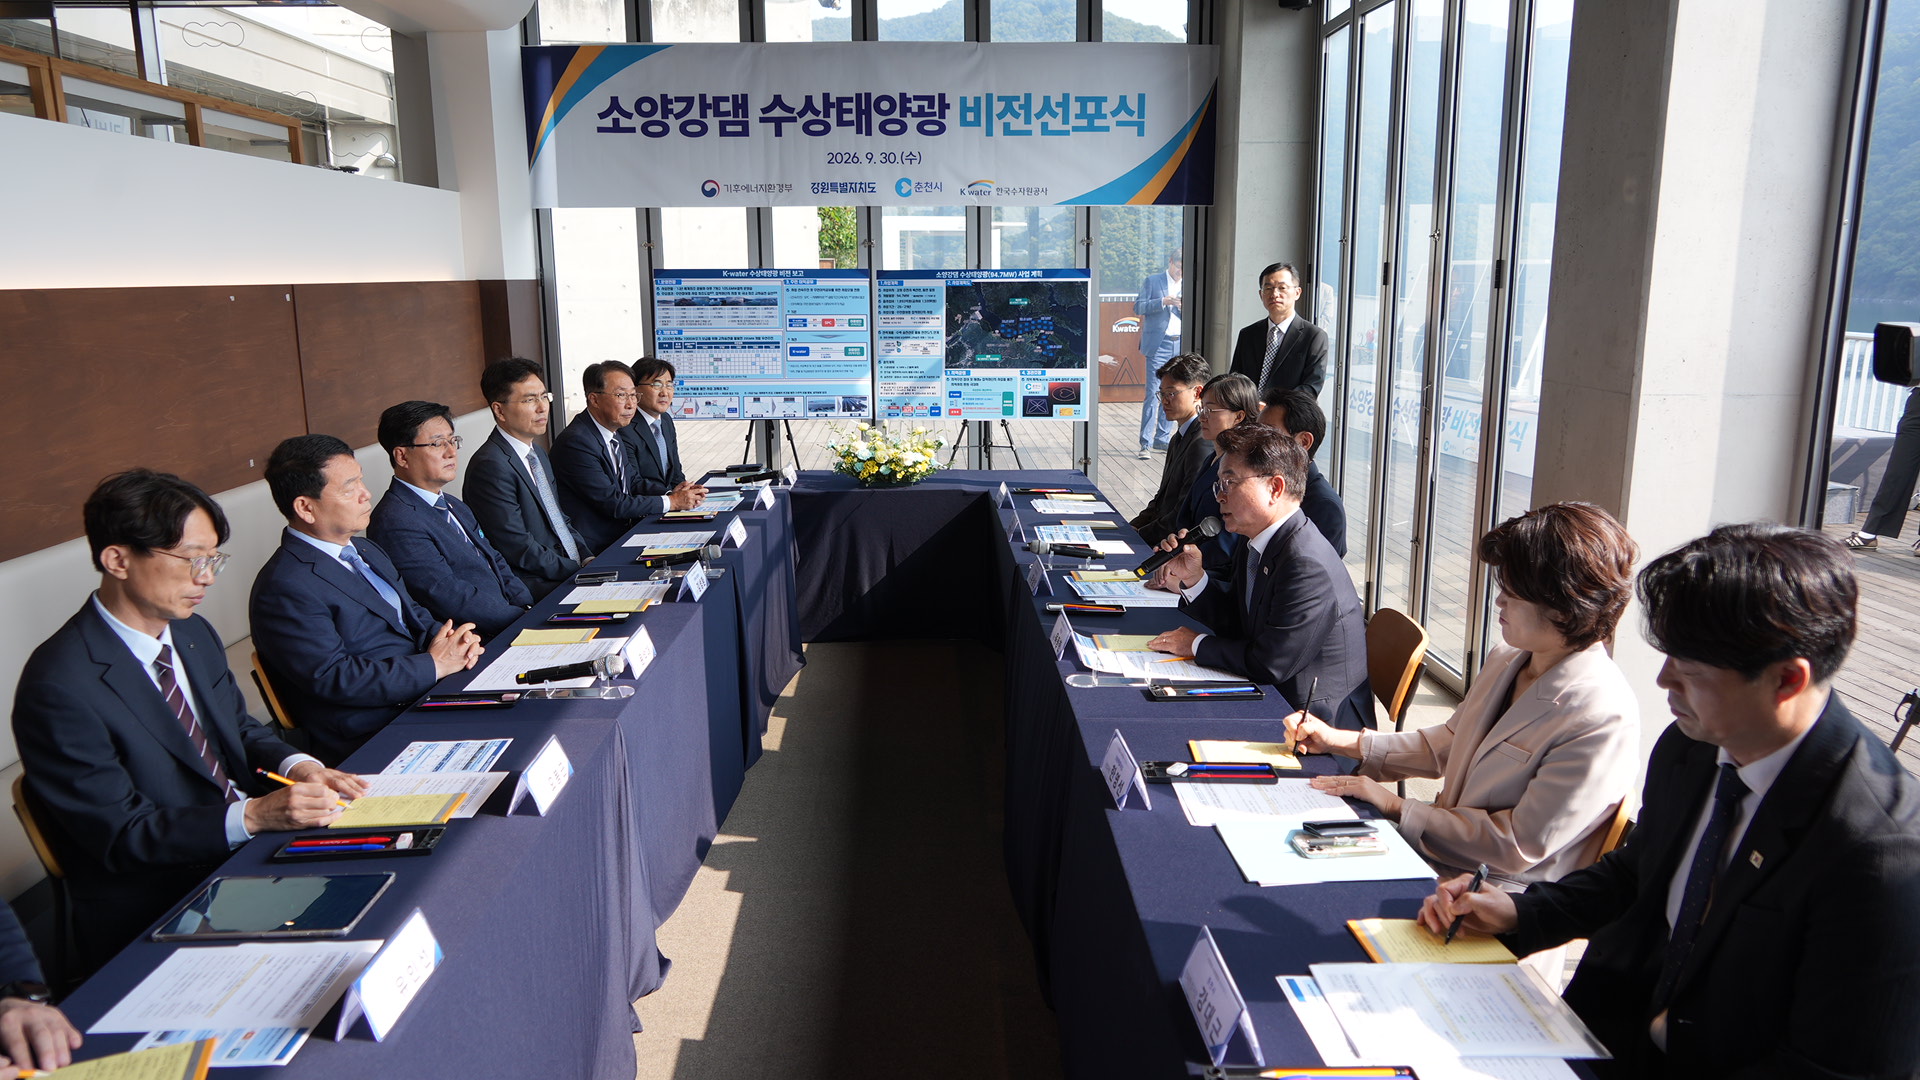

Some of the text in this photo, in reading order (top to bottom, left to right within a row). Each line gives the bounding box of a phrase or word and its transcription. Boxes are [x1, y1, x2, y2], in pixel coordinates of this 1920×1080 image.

[597, 92, 1146, 138] 소양강댐 수상태양광 비전선포식
[827, 151, 922, 166] 2026. 9. 30.(수)
[723, 183, 793, 193] 기후에너지환경부
[811, 182, 877, 194] 강원특별자치도
[914, 181, 943, 193] 춘천시
[996, 186, 1048, 196] 한국수자원공사
[722, 270, 804, 278] K-water 수상태양광 비전 보고
[960, 271, 1017, 279] 수상태양광(94.7MW)
[1197, 986, 1223, 1046] 강대근
